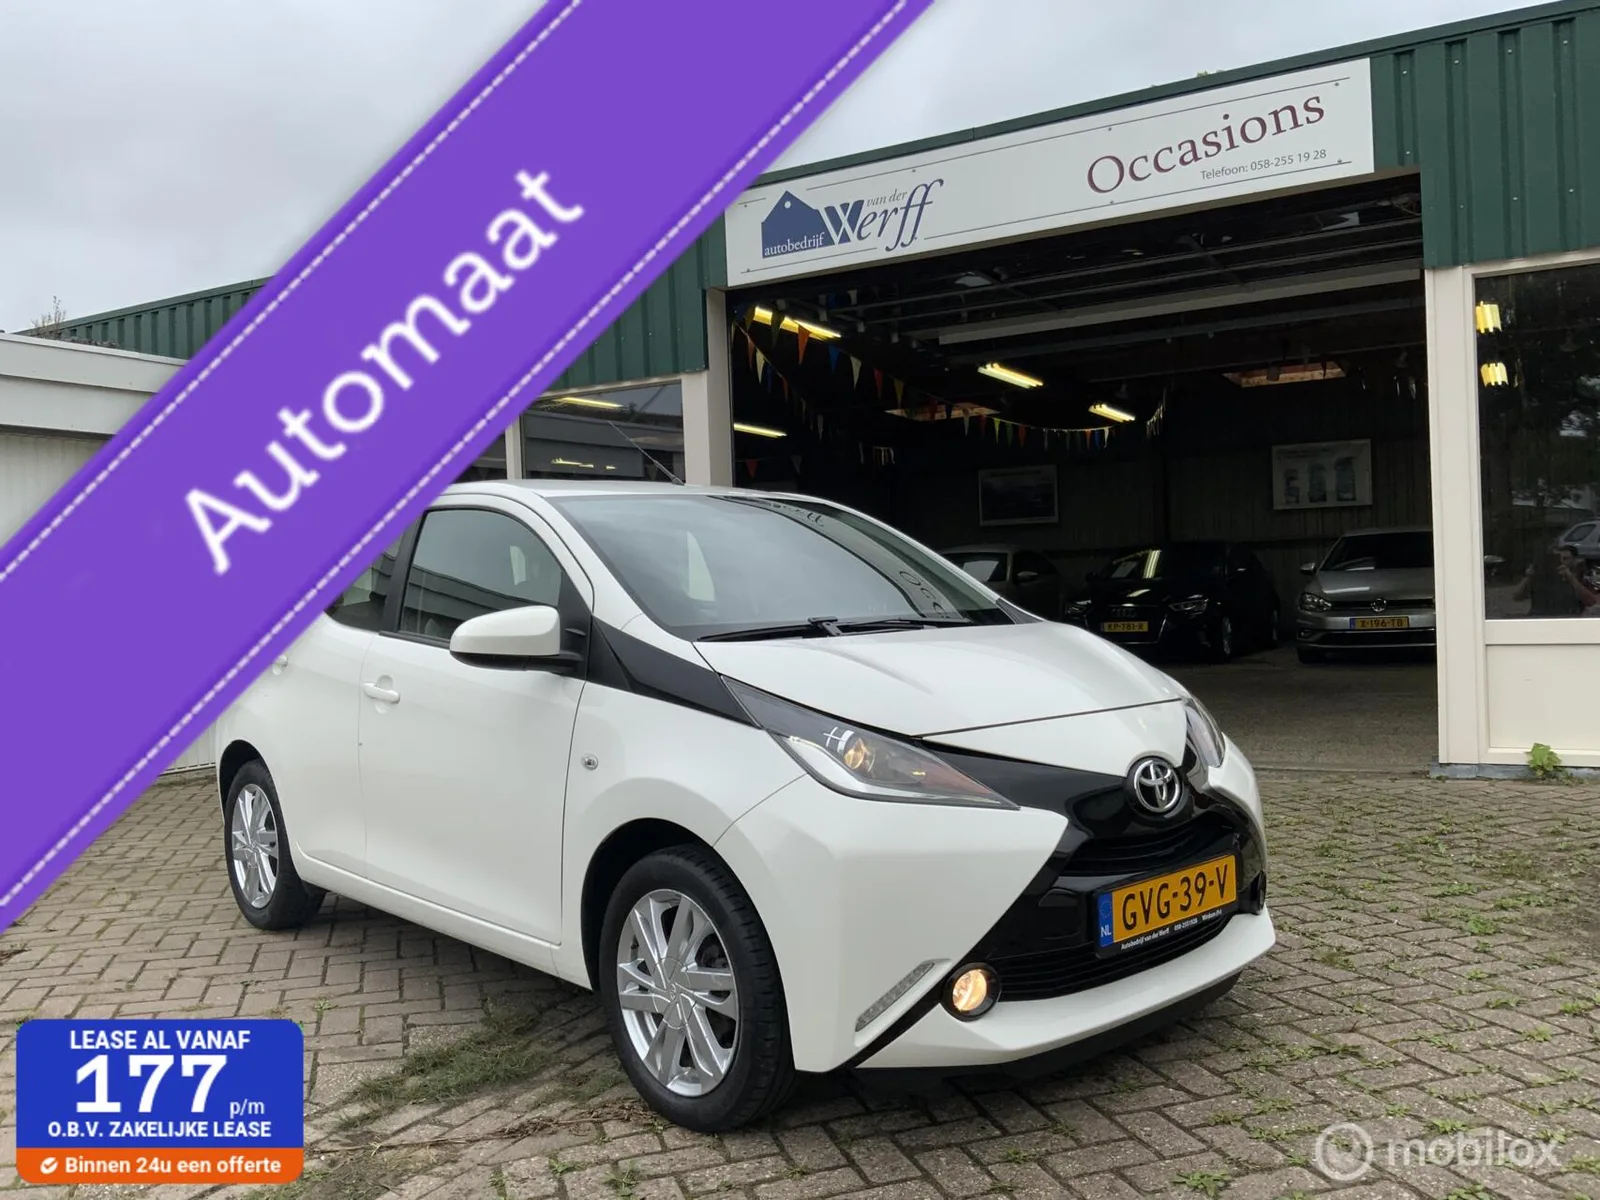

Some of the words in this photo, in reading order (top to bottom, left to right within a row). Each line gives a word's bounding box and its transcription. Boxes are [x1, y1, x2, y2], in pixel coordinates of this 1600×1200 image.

[1087, 96, 1325, 194] Occasions
[1200, 166, 1248, 180] Telefoon:
[1250, 154, 1294, 172] 058-255
[1297, 152, 1310, 163] 19
[1313, 149, 1327, 160] 28
[764, 231, 825, 257] autobedrijf
[814, 178, 944, 253] Werff
[866, 194, 886, 208] van
[888, 188, 908, 202] der
[1122, 864, 1228, 931] GVG-39-V
[1100, 924, 1112, 937] NL
